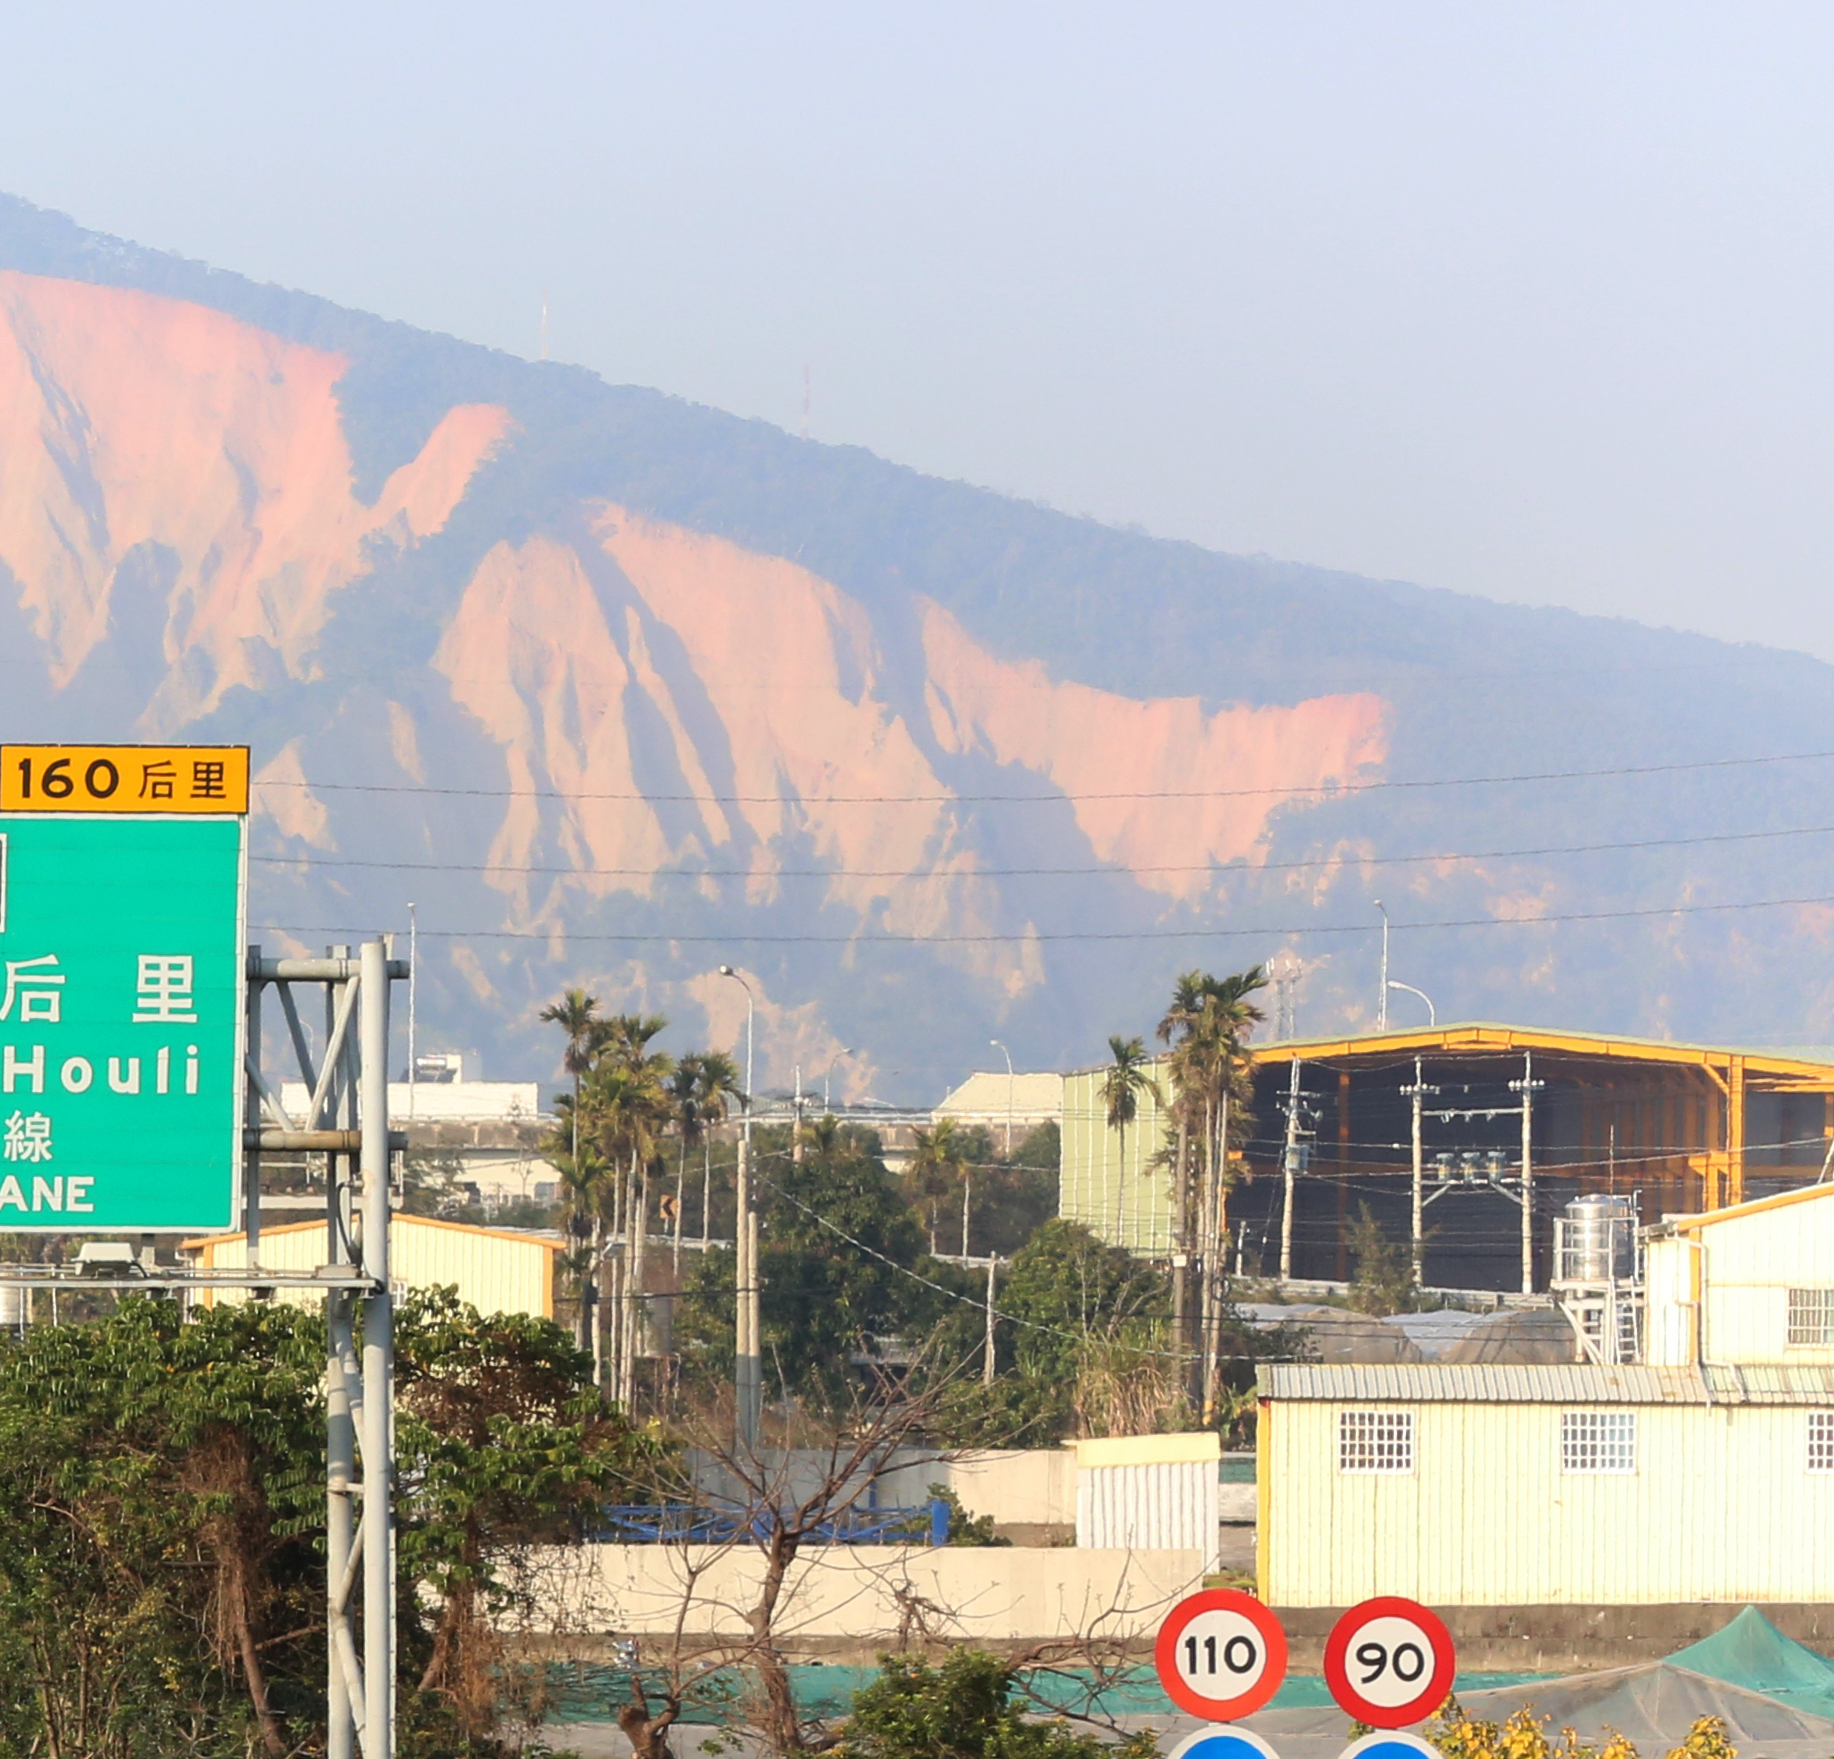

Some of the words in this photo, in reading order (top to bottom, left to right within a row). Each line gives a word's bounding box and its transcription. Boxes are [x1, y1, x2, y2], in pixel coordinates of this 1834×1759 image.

[19, 758, 120, 799] 160
[138, 760, 228, 800] 后里
[3, 1045, 199, 1094] Houli
[1184, 1635, 1256, 1674] 110
[1356, 1642, 1425, 1684] 90
